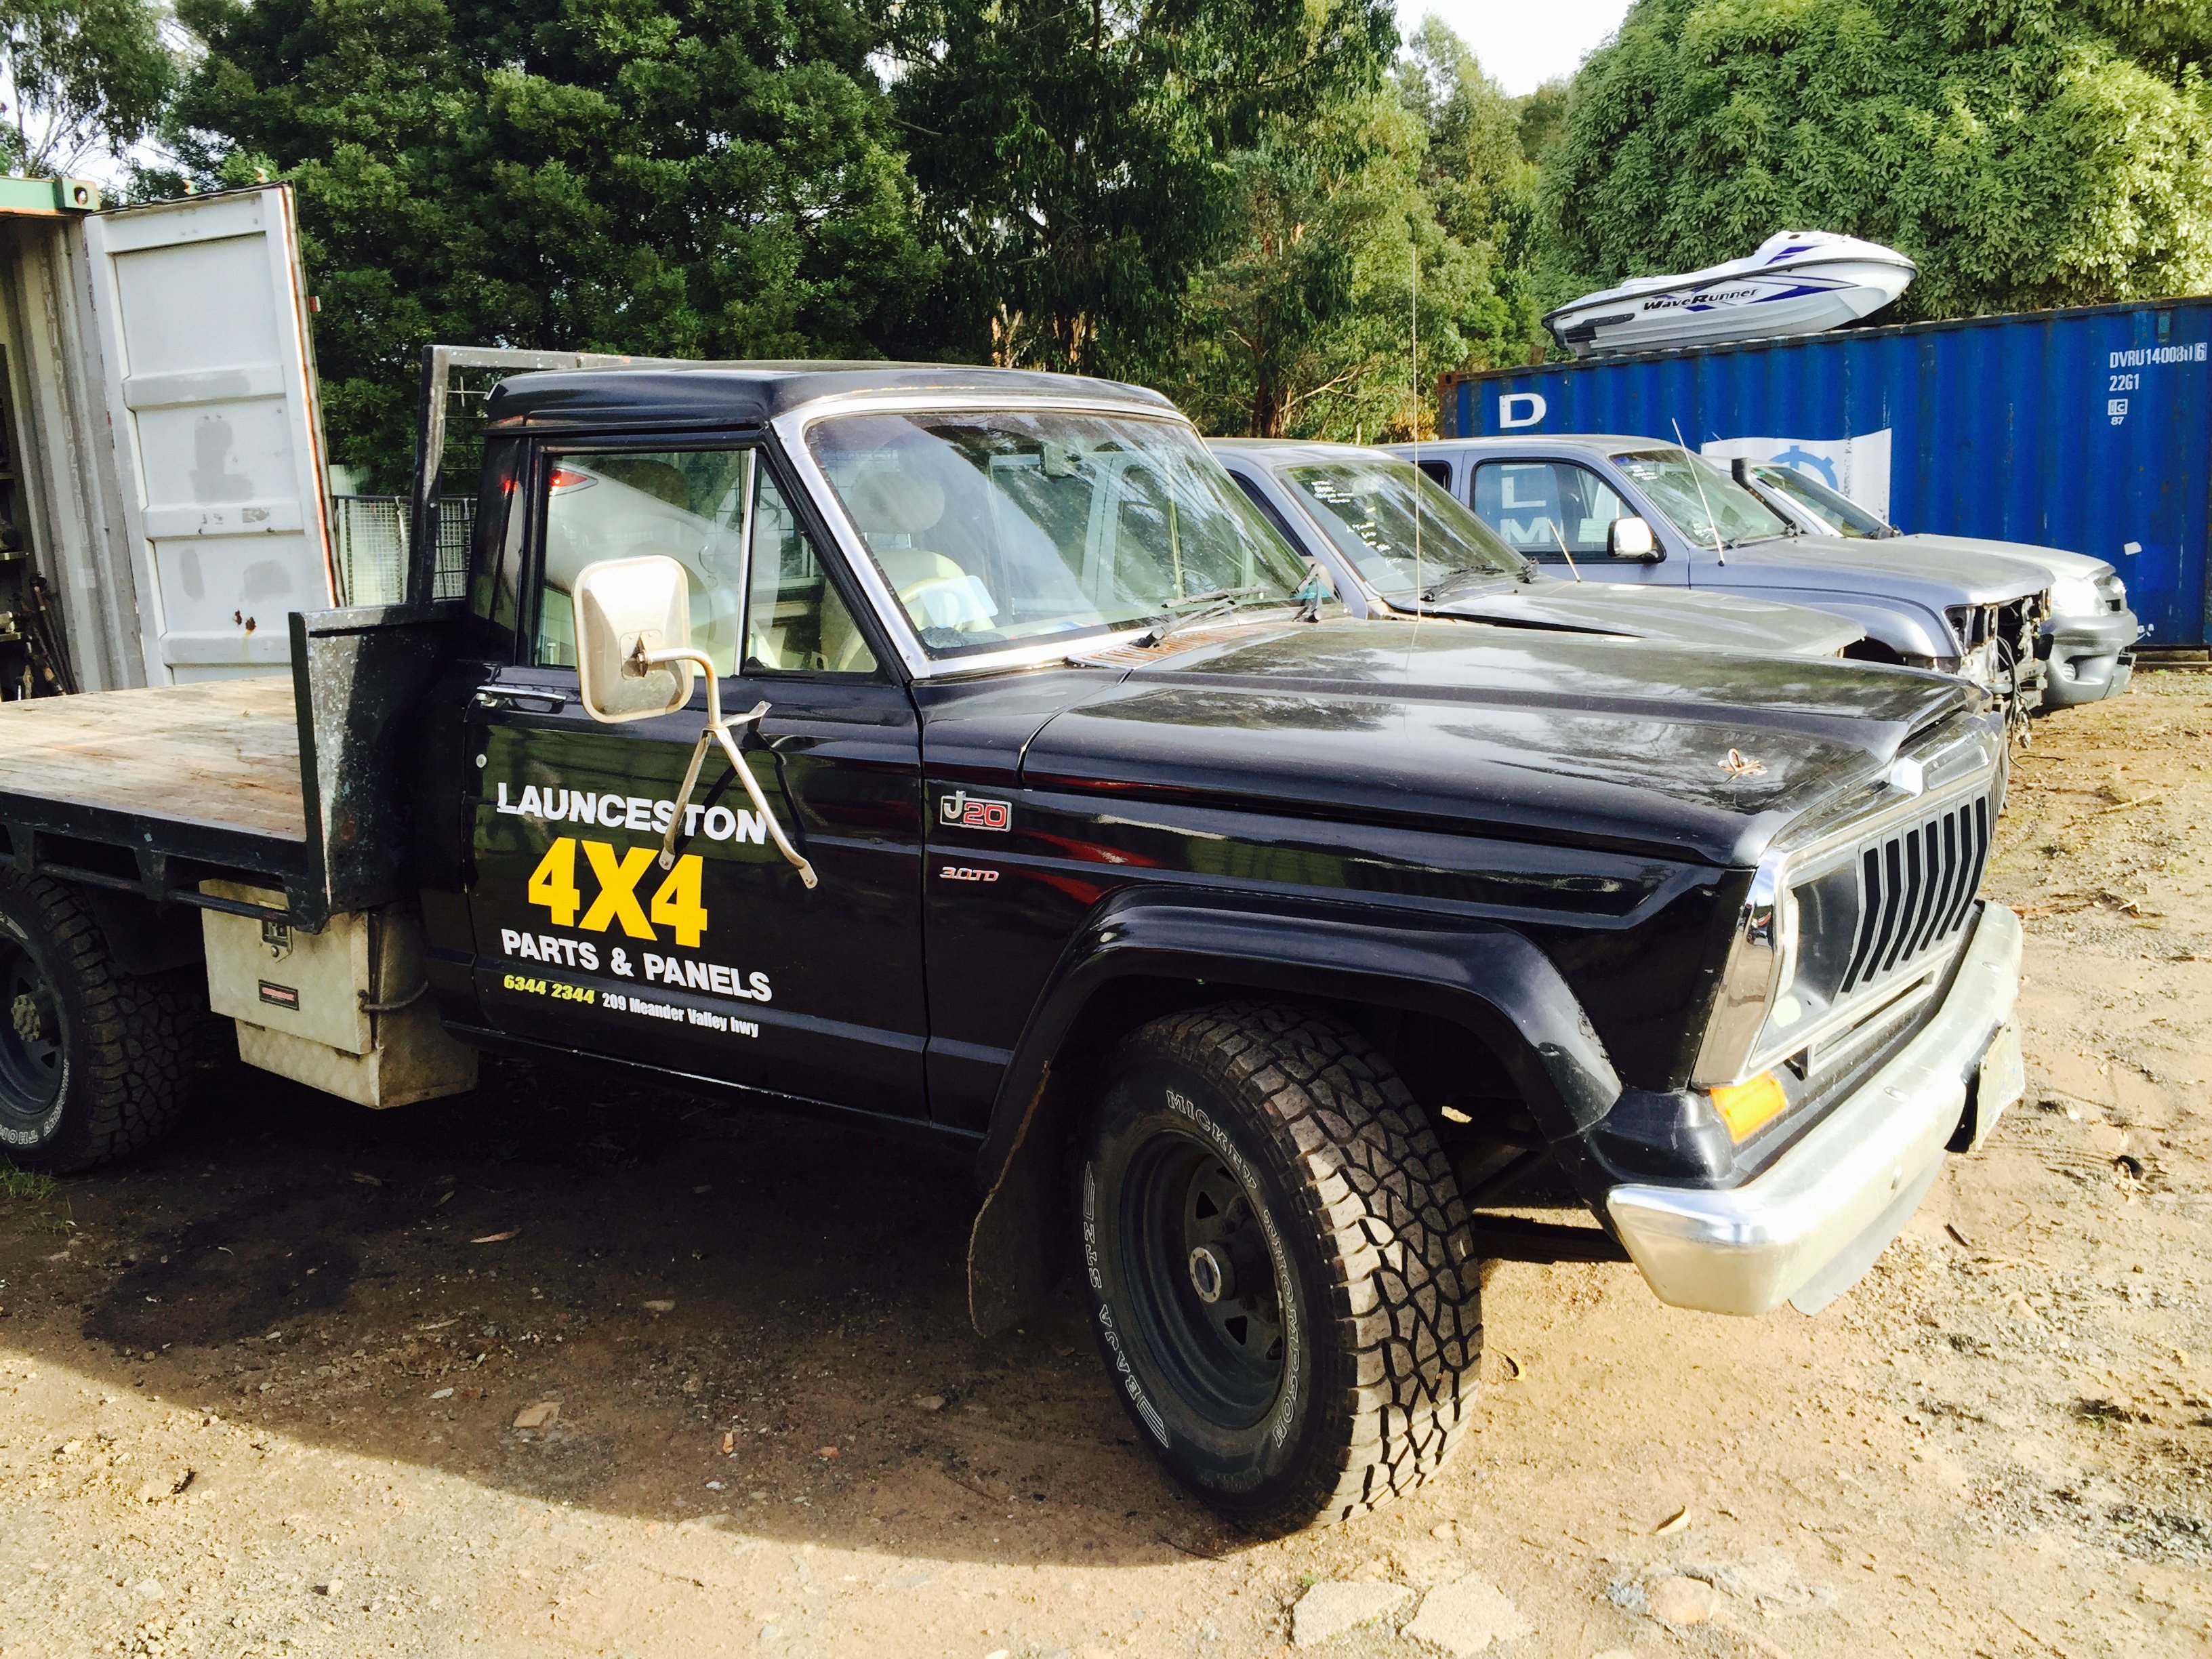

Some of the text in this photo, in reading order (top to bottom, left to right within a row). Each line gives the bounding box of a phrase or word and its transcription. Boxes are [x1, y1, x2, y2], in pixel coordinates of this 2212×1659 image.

[1643, 288, 1759, 311] WaveRunner
[2109, 373, 2139, 391] 22G1
[2110, 416, 2125, 426] 87
[497, 783, 767, 845] LAUNCESTON
[943, 790, 1007, 827] J20
[528, 836, 708, 948] 4X4
[500, 928, 773, 1002] PARTS & PANELS
[504, 975, 759, 1038] 6344 2344 209 Meander Valley hwy
[1166, 1089, 1300, 1449] MICKEY THOMPSON
[1099, 1303, 1142, 1401] BAJA
